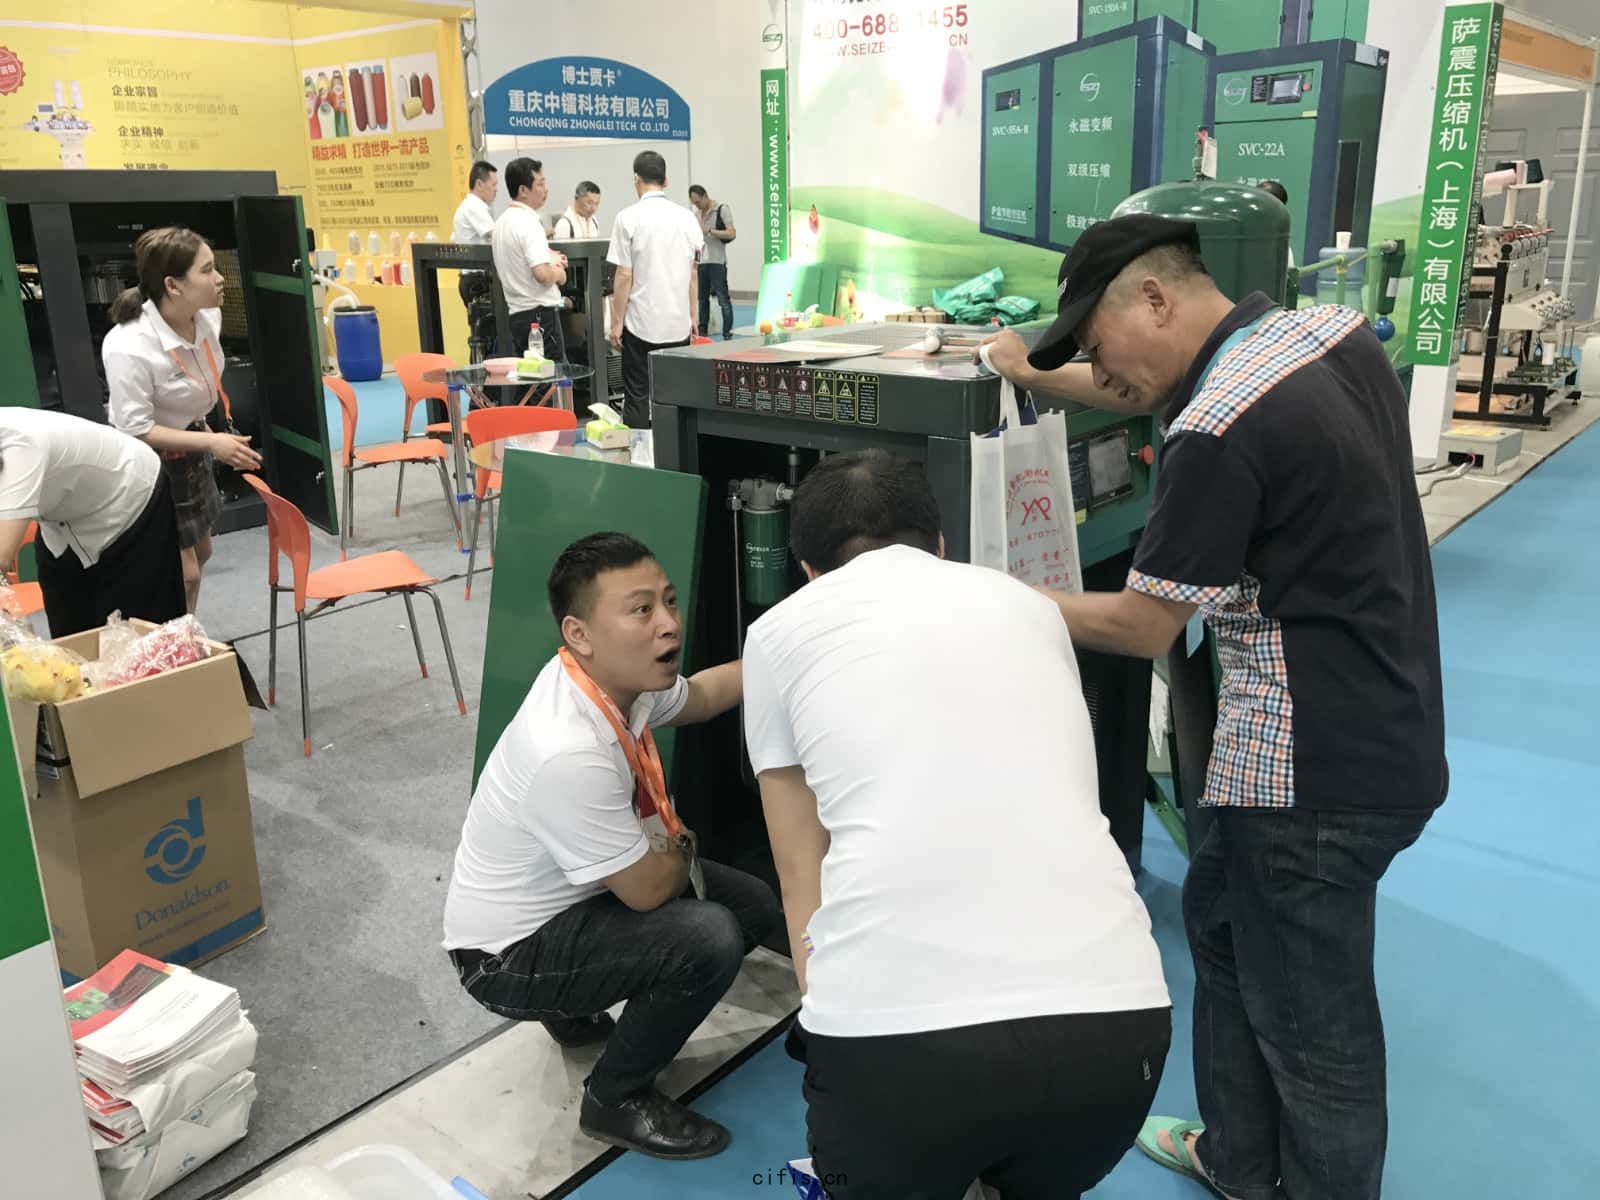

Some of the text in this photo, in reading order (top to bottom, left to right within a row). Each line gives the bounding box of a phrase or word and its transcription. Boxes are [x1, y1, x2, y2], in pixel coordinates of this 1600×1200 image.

[508, 89, 669, 119] 重庆中镭科技有限公司
[509, 116, 568, 130] CHONGQING
[570, 118, 614, 130] ZHONGLEI
[616, 121, 637, 132] TECH
[1068, 116, 1113, 133] 永磁变频
[1238, 143, 1285, 156] SVC-22A
[1067, 163, 1111, 178] 双级压缩
[1415, 17, 1482, 355] 萨震压缩机（上海）有限公司
[134, 879, 231, 930] Donaldson
